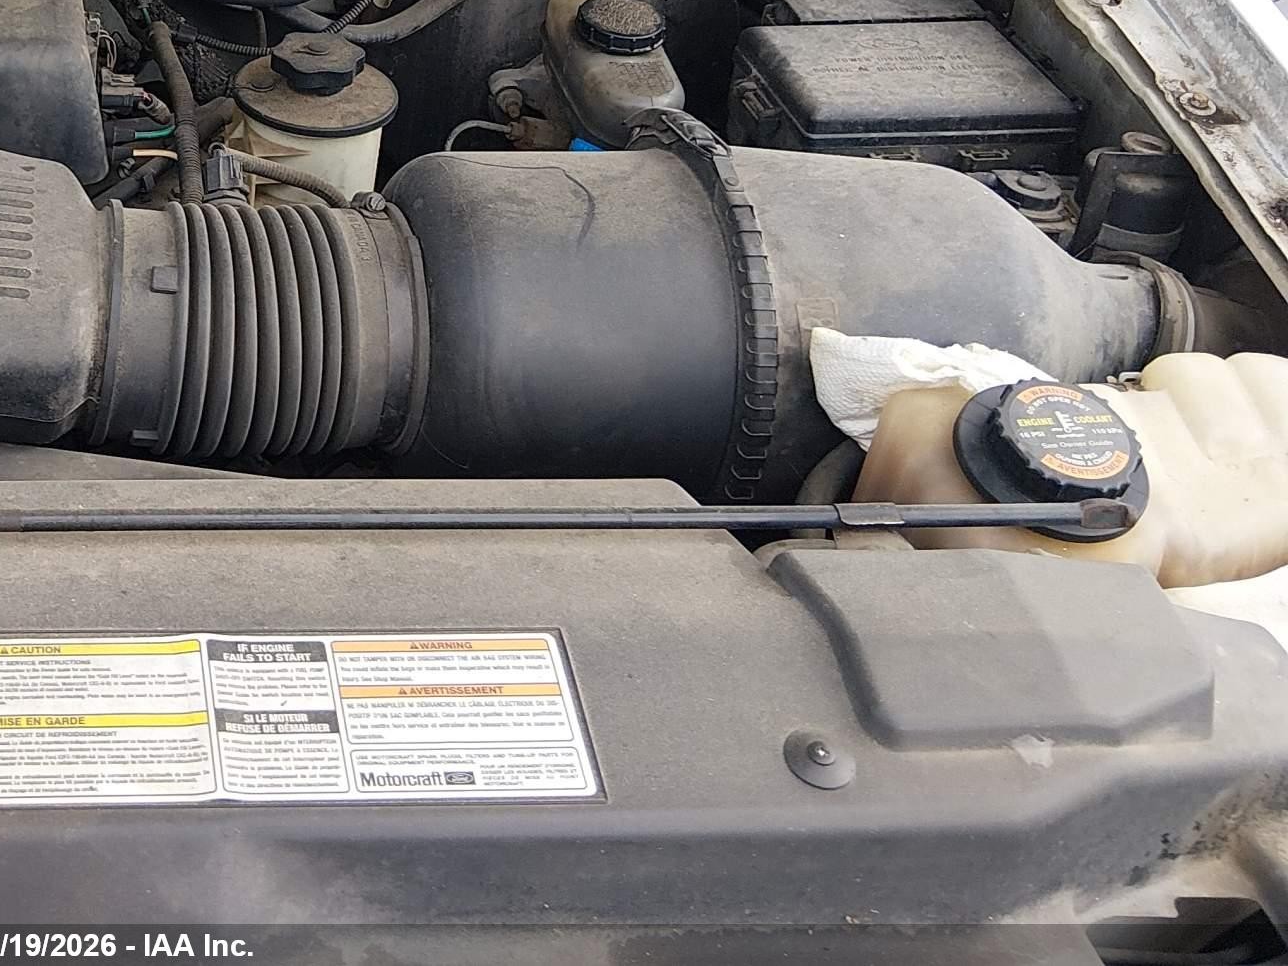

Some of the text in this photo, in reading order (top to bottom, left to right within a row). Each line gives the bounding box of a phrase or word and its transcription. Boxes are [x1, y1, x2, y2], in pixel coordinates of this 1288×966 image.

[1016, 415, 1113, 427] ENGINE COOLANT
[10, 646, 62, 654] CAUTION
[237, 643, 294, 652] IF ENGINE
[417, 641, 472, 650] WARNING
[223, 652, 312, 662] FAILS TO START
[410, 686, 504, 696] AVERTISSEMENT
[26, 718, 42, 726] EN
[45, 716, 85, 726] GARDE
[243, 713, 308, 724] SI LE MOTEUR
[225, 722, 330, 733] REFUSE DE DÉMARRER
[359, 771, 444, 788] Motorcraft
